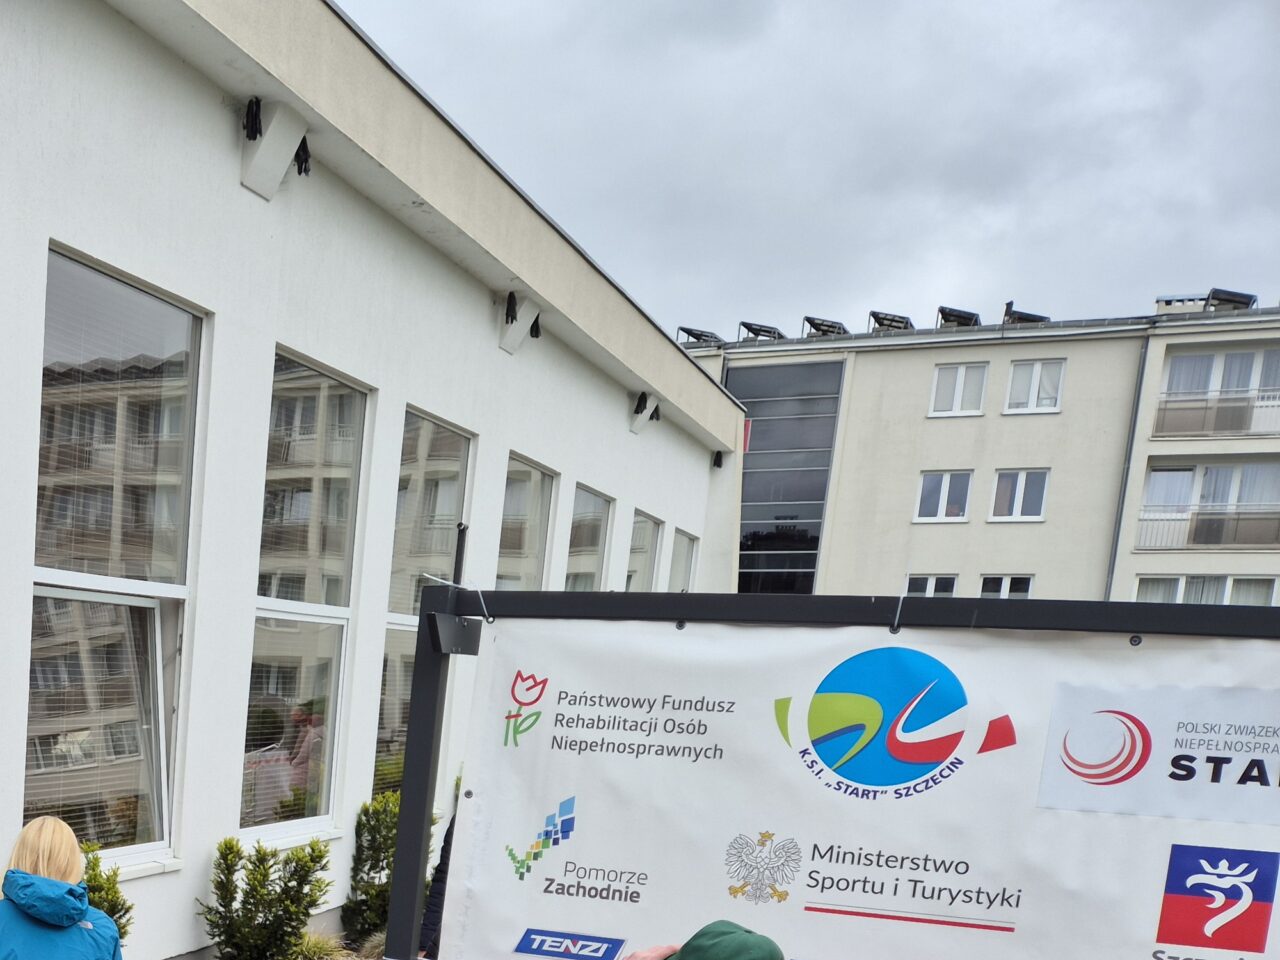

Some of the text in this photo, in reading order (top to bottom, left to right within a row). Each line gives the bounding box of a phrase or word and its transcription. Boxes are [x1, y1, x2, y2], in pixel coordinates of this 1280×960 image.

[557, 690, 736, 714] Państwowy Fundusz
[554, 712, 708, 737] Rehabilitacji Osób
[1176, 721, 1280, 739] POLSKI ZWIĄZEK
[551, 735, 724, 763] Niepełnosprawnych
[798, 748, 823, 780] K.S.I.
[894, 756, 965, 800] SZCZECIN
[1168, 754, 1280, 788] STA
[810, 843, 970, 875] Ministerstwo
[563, 861, 648, 886] Pomorze
[543, 877, 641, 904] Zachodnie
[806, 869, 1023, 910] Sportu i Turystyki
[530, 934, 609, 957] TENZI
